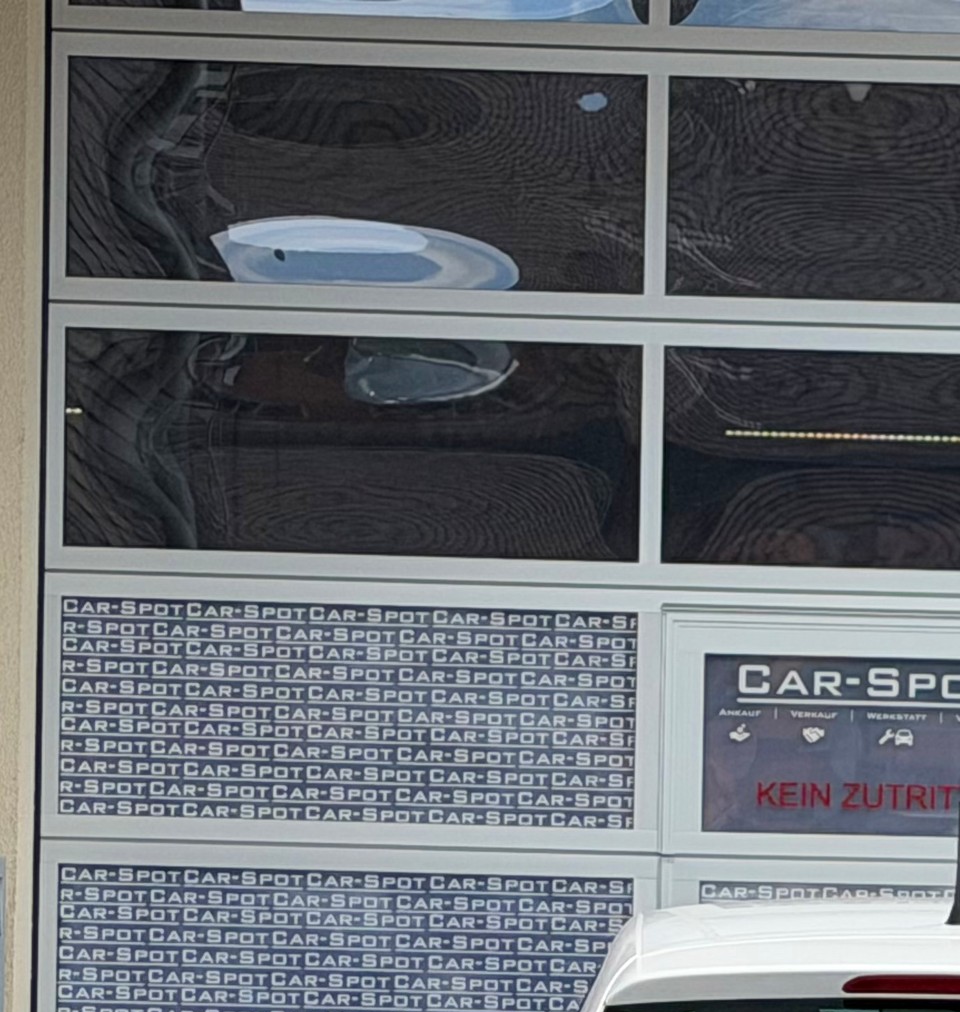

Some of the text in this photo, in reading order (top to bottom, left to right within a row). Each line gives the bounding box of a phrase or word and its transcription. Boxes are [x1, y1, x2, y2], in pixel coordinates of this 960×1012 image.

[63, 599, 552, 626] CAR-SPOT CAR-SPOT CAR-SPOT CAR-SPOT
[152, 622, 519, 645] CAR-SPOT CAR-SPOT CAR-SPOT
[62, 638, 552, 665] CAR-SPOT CAR-SPOT CAR-SPOT CAR-SPOT
[151, 661, 519, 684] CAR-SPOT CAR-SPOT CAR-SPOT
[61, 679, 551, 706] CAR-SPOT CAR-SPOT CAR-SPOT CAR-SPOT
[151, 702, 518, 725] CAR-SPOT CAR-SPOT CAR-SPOT
[61, 717, 550, 744] CAR-SPOT CAR-SPOT CAR-SPOT CAR-SPOT
[150, 740, 517, 763] CAR-SPOT CAR-SPOT CAR-SPOT
[60, 758, 550, 785] CAR-SPOT CAR-SPOT CAR-SPOT CAR-SPOT
[149, 781, 516, 804] CAR-SPOT CAR-SPOT CAR-SPOT
[756, 781, 831, 808] KEIN
[59, 799, 549, 825] CAR-SPOT CAR-SPOT CAR-SPOT CAR-SPOT
[61, 867, 549, 892] CAR-SPOT CAR-SPOT CAR-SPOT CAR-SPOT
[149, 889, 516, 911] CAR-SPOT CAR-SPOT CAR-SPOT
[60, 906, 549, 931] CAR-SPOT CAR-SPOT CAR-SPOT CAR-SPOT
[149, 928, 515, 950] CAR-SPOT CAR-SPOT CAR-SPOT
[59, 946, 548, 972] CAR-SPOT CAR-SPOT CAR-SPOT CAR-SPOT
[148, 969, 515, 991] CAR-SPOT CAR-SPOT CAR-SPOT
[58, 985, 546, 1010] CAR-SPOT CAR-SPOT CAR-SPOT CAR-SPOT
